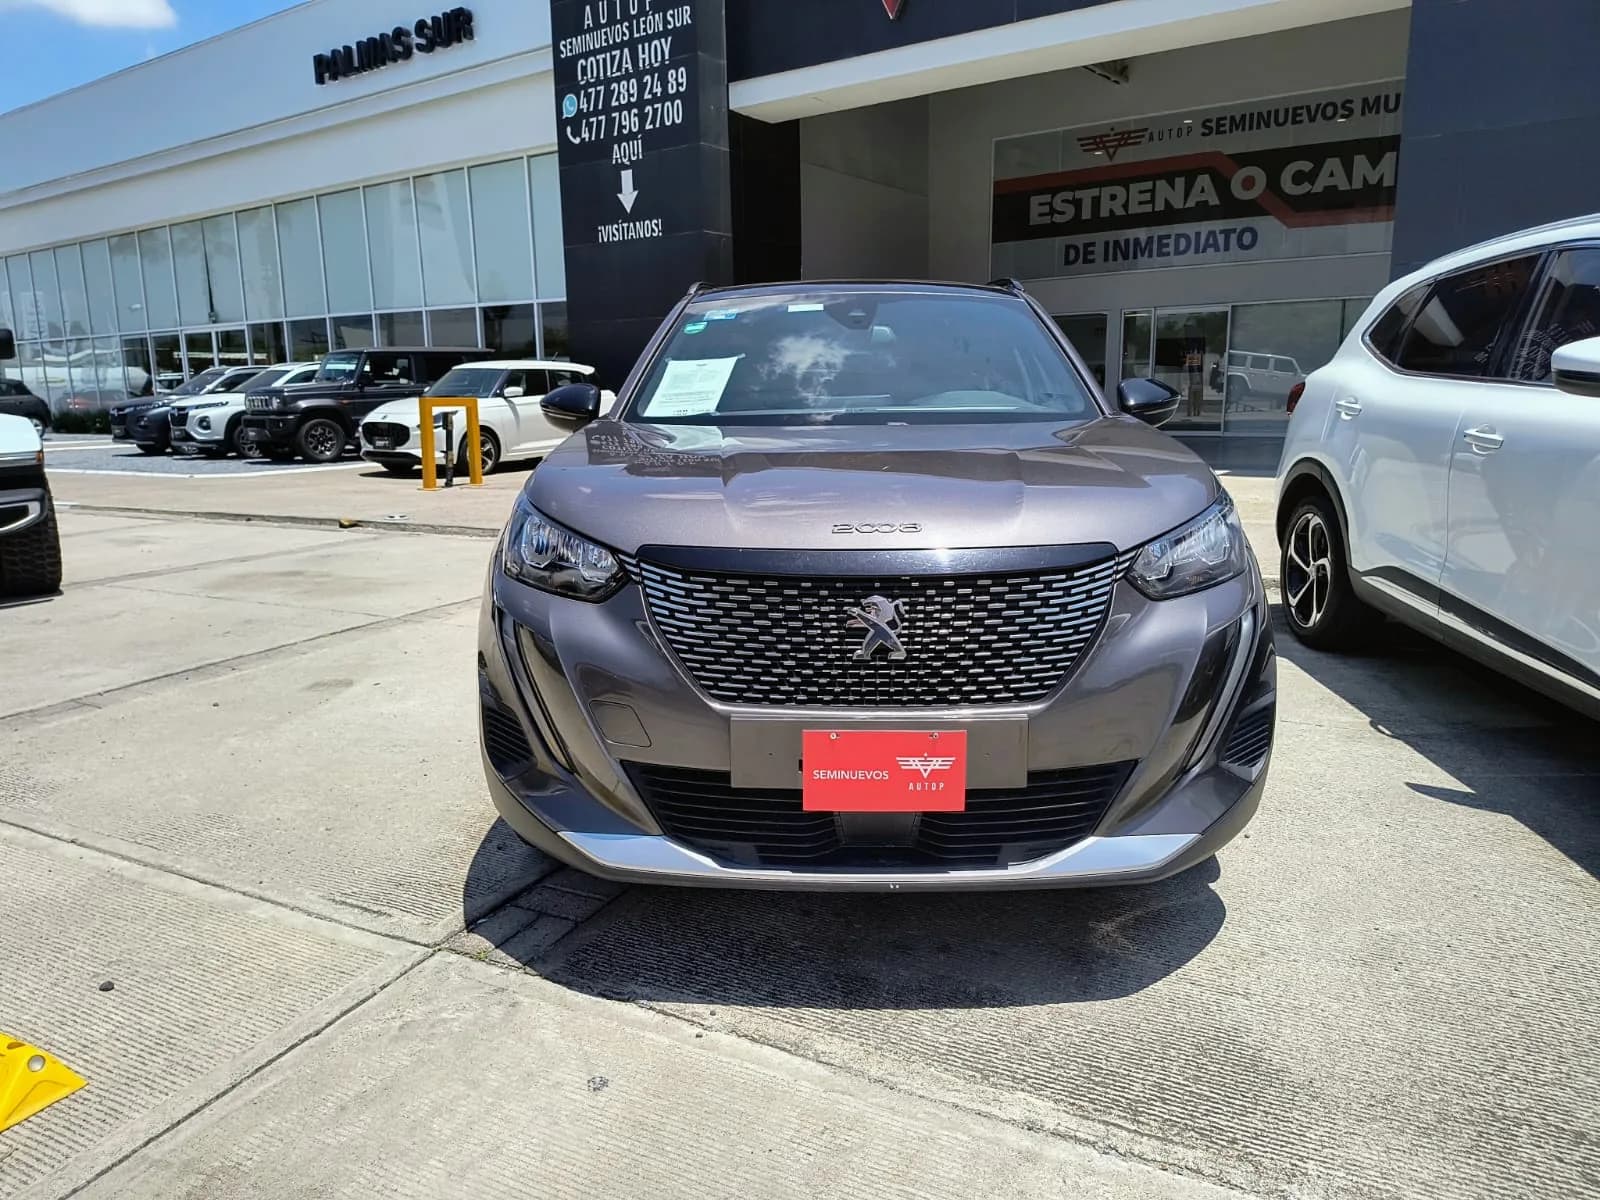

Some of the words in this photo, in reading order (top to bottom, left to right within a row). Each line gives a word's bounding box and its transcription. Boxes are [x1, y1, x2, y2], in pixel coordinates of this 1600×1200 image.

[313, 26, 414, 85] PALMAS
[414, 7, 474, 54] SUR
[559, 21, 630, 59] SEMINUEVOS
[633, 11, 664, 38] LEÓN
[666, 5, 692, 29] SUR
[577, 47, 634, 85] COTIZA
[637, 36, 672, 71] HOY
[579, 85, 605, 113] 477
[610, 78, 638, 107] 289
[642, 72, 662, 100] 24
[667, 66, 687, 95] 89
[581, 114, 606, 142] 477
[611, 108, 639, 137] 796
[644, 99, 683, 131] 2700
[1147, 126, 1194, 143] AUTOP
[1200, 98, 1355, 137] SEMINUEVOS
[1360, 93, 1401, 117] MU
[612, 134, 643, 165] AQUÍ
[1028, 173, 1221, 226] ESTRENA
[1230, 165, 1268, 201] O
[1279, 151, 1397, 197] CAM
[598, 218, 663, 243] ¡VISÍTANOS!
[1063, 243, 1096, 267] DE
[1103, 226, 1259, 263] INMEDIATO
[832, 523, 922, 534] 2008
[812, 769, 889, 780] SEMINUEVOS
[908, 782, 945, 791] AUTOP
